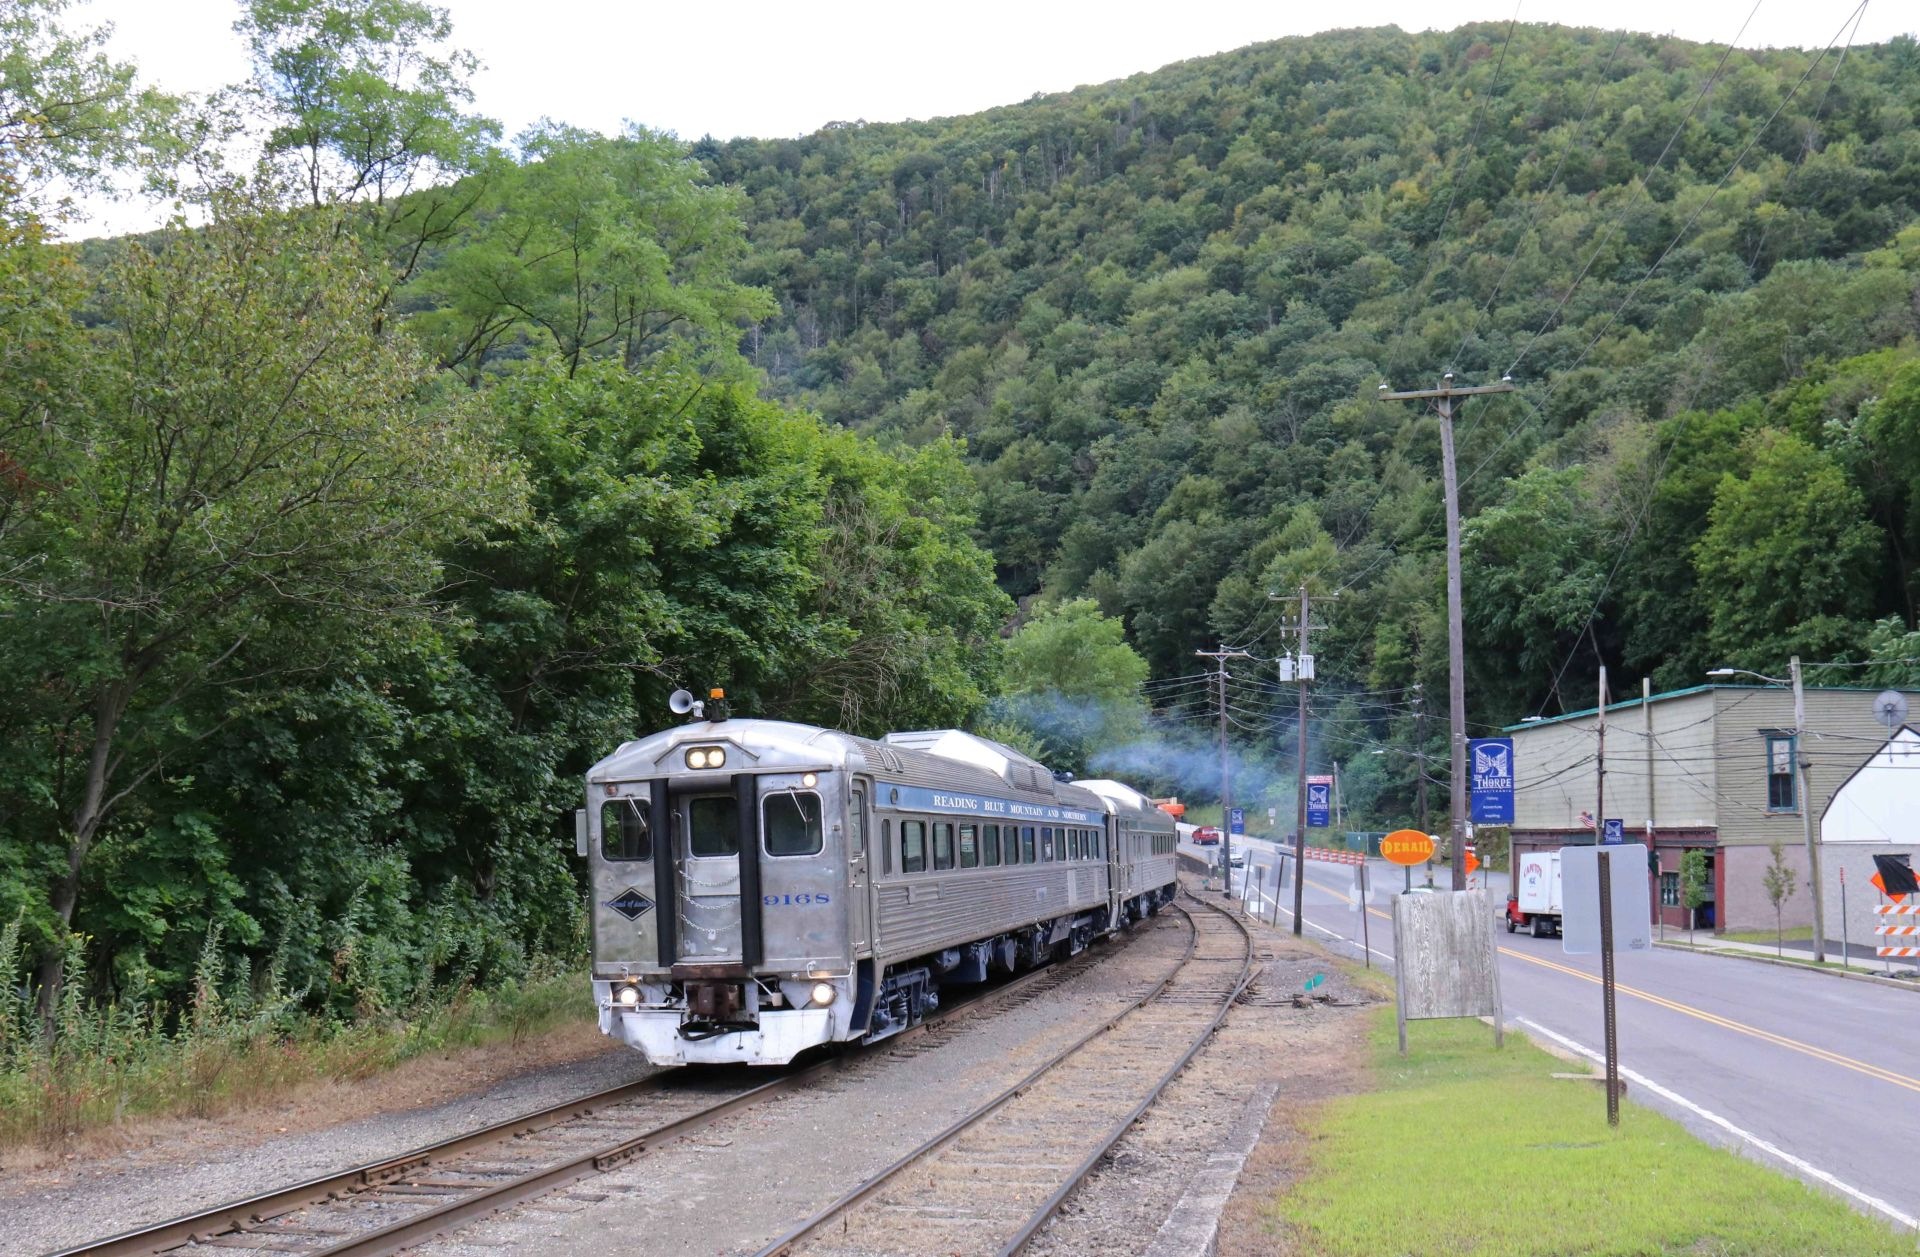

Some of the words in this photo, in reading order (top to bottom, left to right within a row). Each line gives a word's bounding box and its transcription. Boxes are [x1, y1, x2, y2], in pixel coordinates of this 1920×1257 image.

[1475, 775, 1512, 790] THORPE
[934, 795, 977, 809] READING
[984, 801, 1005, 812] BLUE
[1010, 805, 1043, 816] MOUNTAIN
[1048, 809, 1059, 818] AND
[1062, 811, 1087, 821] NORTHERN
[1384, 840, 1430, 855] DERAIL
[763, 893, 830, 906] 9168
